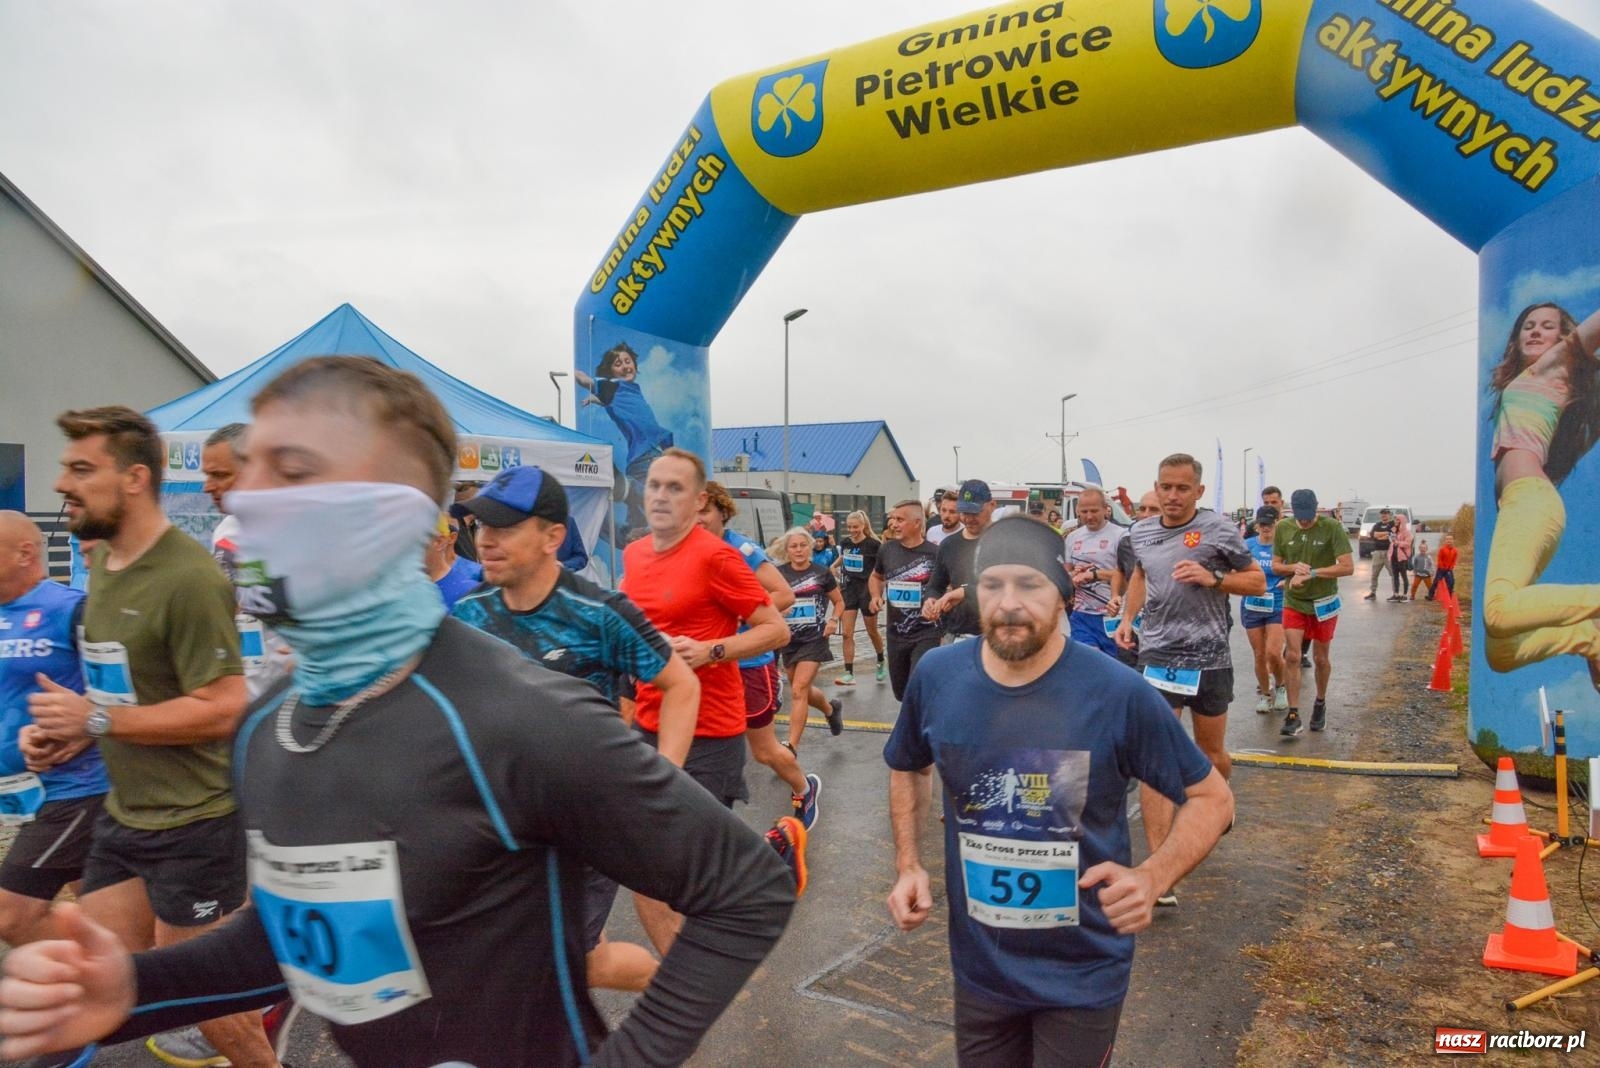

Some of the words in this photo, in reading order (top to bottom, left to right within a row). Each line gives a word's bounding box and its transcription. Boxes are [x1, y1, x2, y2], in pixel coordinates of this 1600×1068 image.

[898, 1, 1064, 56] Gmina
[856, 25, 1112, 107] Pietrowice
[886, 75, 1080, 139] Wielkie
[1317, 13, 1559, 193] aktywnych
[590, 206, 651, 294] Gmina
[648, 125, 702, 204] ludzi
[611, 152, 727, 315] aktywnych
[574, 463, 599, 475] MITKO
[896, 589, 912, 601] 70
[1165, 665, 1178, 681] 8
[985, 843, 1015, 854] Cross
[1018, 847, 1050, 857] przez
[989, 869, 1041, 905] 59
